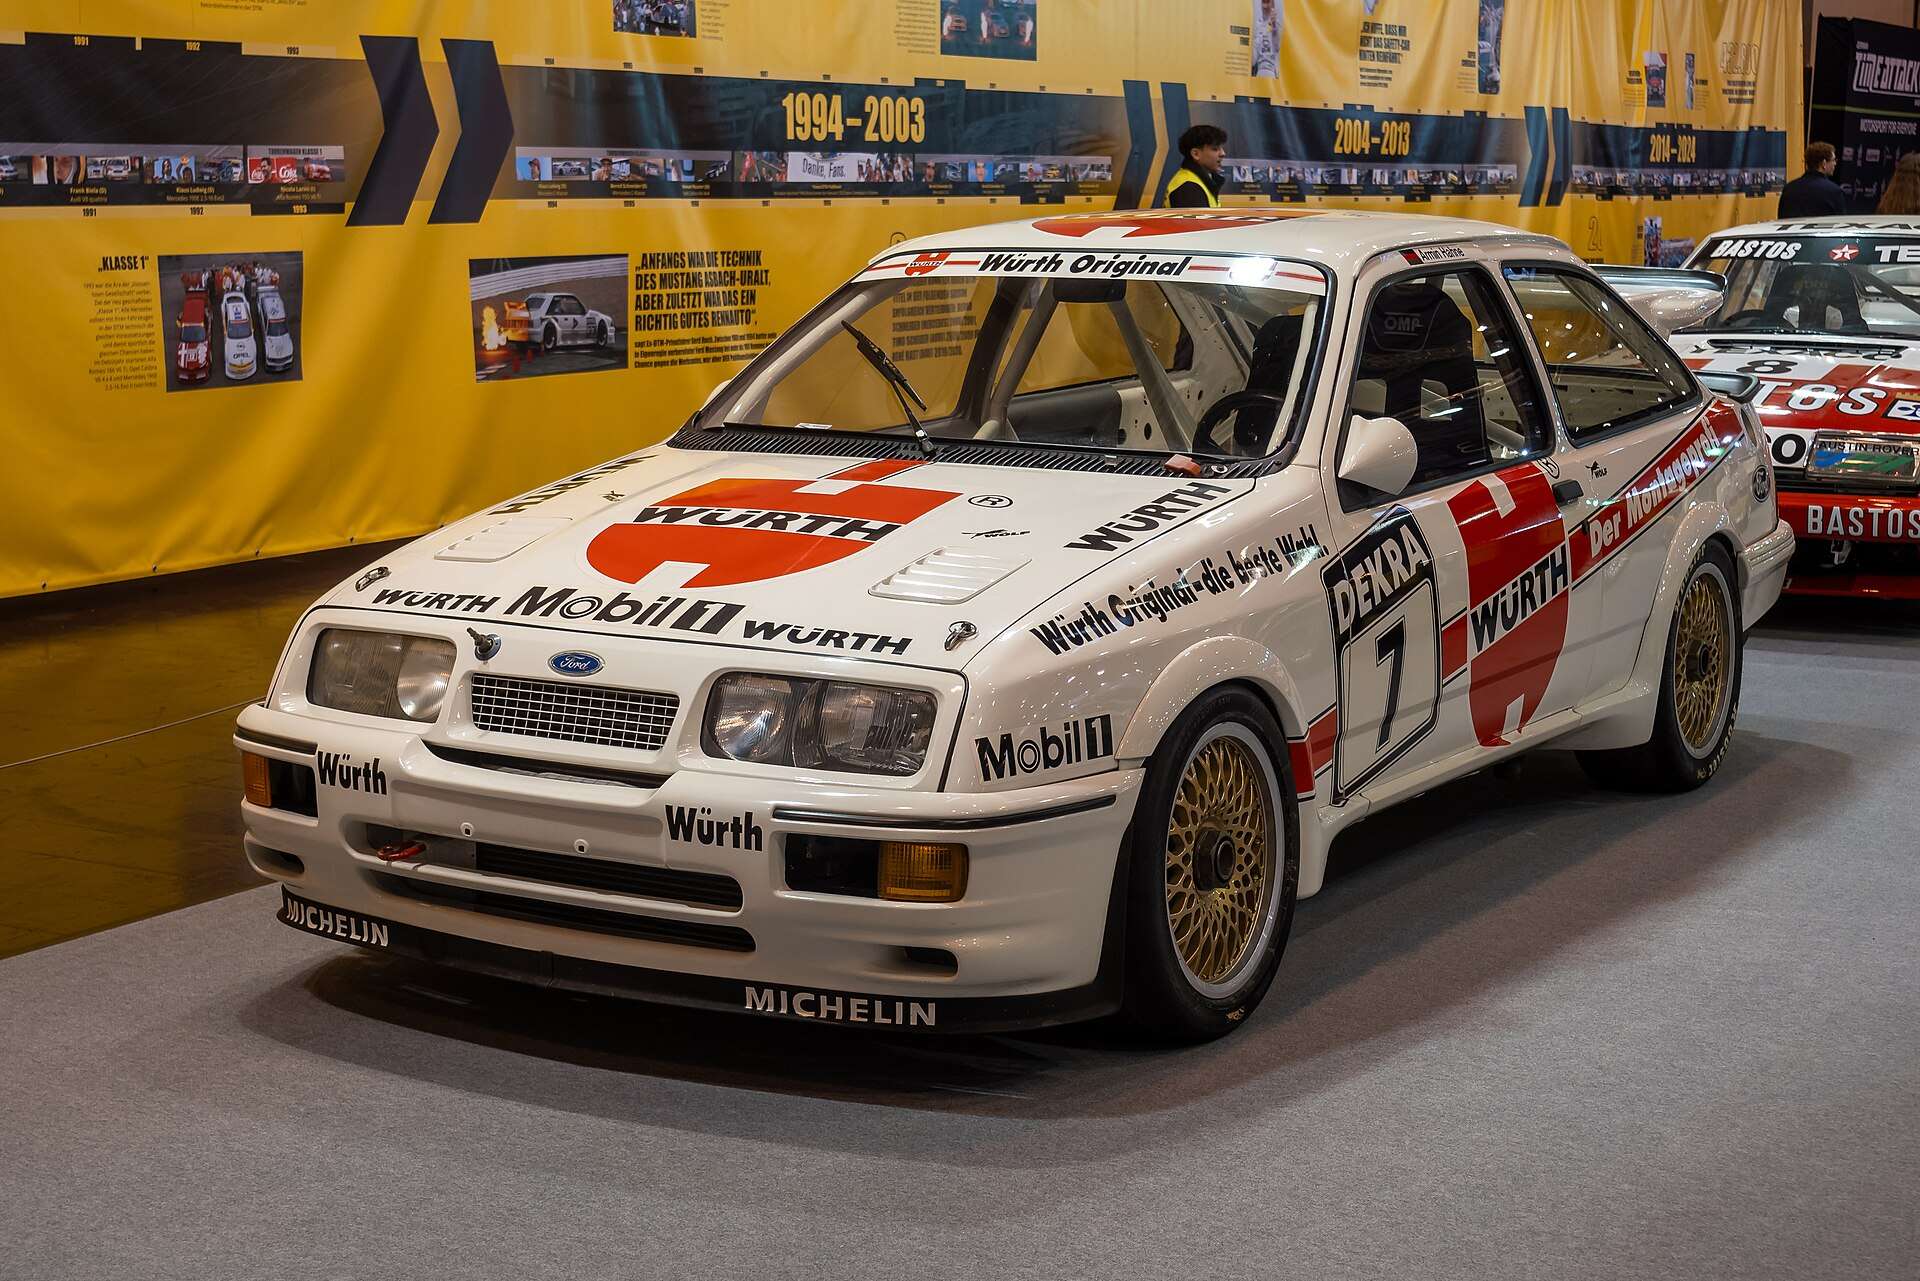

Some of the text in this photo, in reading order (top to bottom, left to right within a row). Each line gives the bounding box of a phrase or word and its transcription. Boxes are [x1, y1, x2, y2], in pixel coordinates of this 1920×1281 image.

[74, 36, 89, 47] 1991
[802, 158, 847, 179] Danke, Fans.
[82, 208, 97, 217] 1991
[190, 207, 204, 215] 1992
[292, 204, 308, 214] 1993
[635, 250, 762, 272] „ANFANGS WAR DIE TECHNIK
[1710, 240, 1802, 260] BASTOS
[978, 252, 1193, 278] Würth Original
[635, 273, 656, 290] DES
[659, 272, 702, 289] MUSTANG
[635, 290, 756, 311] ABER ZULETZT WAR DAS EIN
[635, 313, 678, 331] RICHTIG
[680, 311, 709, 329] GUTES
[1384, 316, 1424, 332] OMP
[1736, 360, 1798, 375] 8
[1818, 440, 1920, 456] AUSTIN ROVER
[633, 507, 901, 541] WÜRTH
[1064, 482, 1232, 552] WÜRTH
[1807, 505, 1920, 537] BASTOS
[1588, 511, 1621, 558] Der
[1334, 524, 1430, 635] DEKRA
[1030, 601, 1118, 656] Würth
[1227, 546, 1282, 585] beste
[1470, 545, 1568, 654] WÜRTH
[371, 589, 502, 613] WÜRTH
[743, 619, 913, 656] WÜRTH
[559, 656, 592, 671] Ford
[1376, 615, 1406, 753] 7
[318, 751, 388, 796] Würth
[665, 804, 763, 852] Würth
[286, 899, 389, 947] MICHELIN
[744, 986, 936, 1026] MICHELIN
